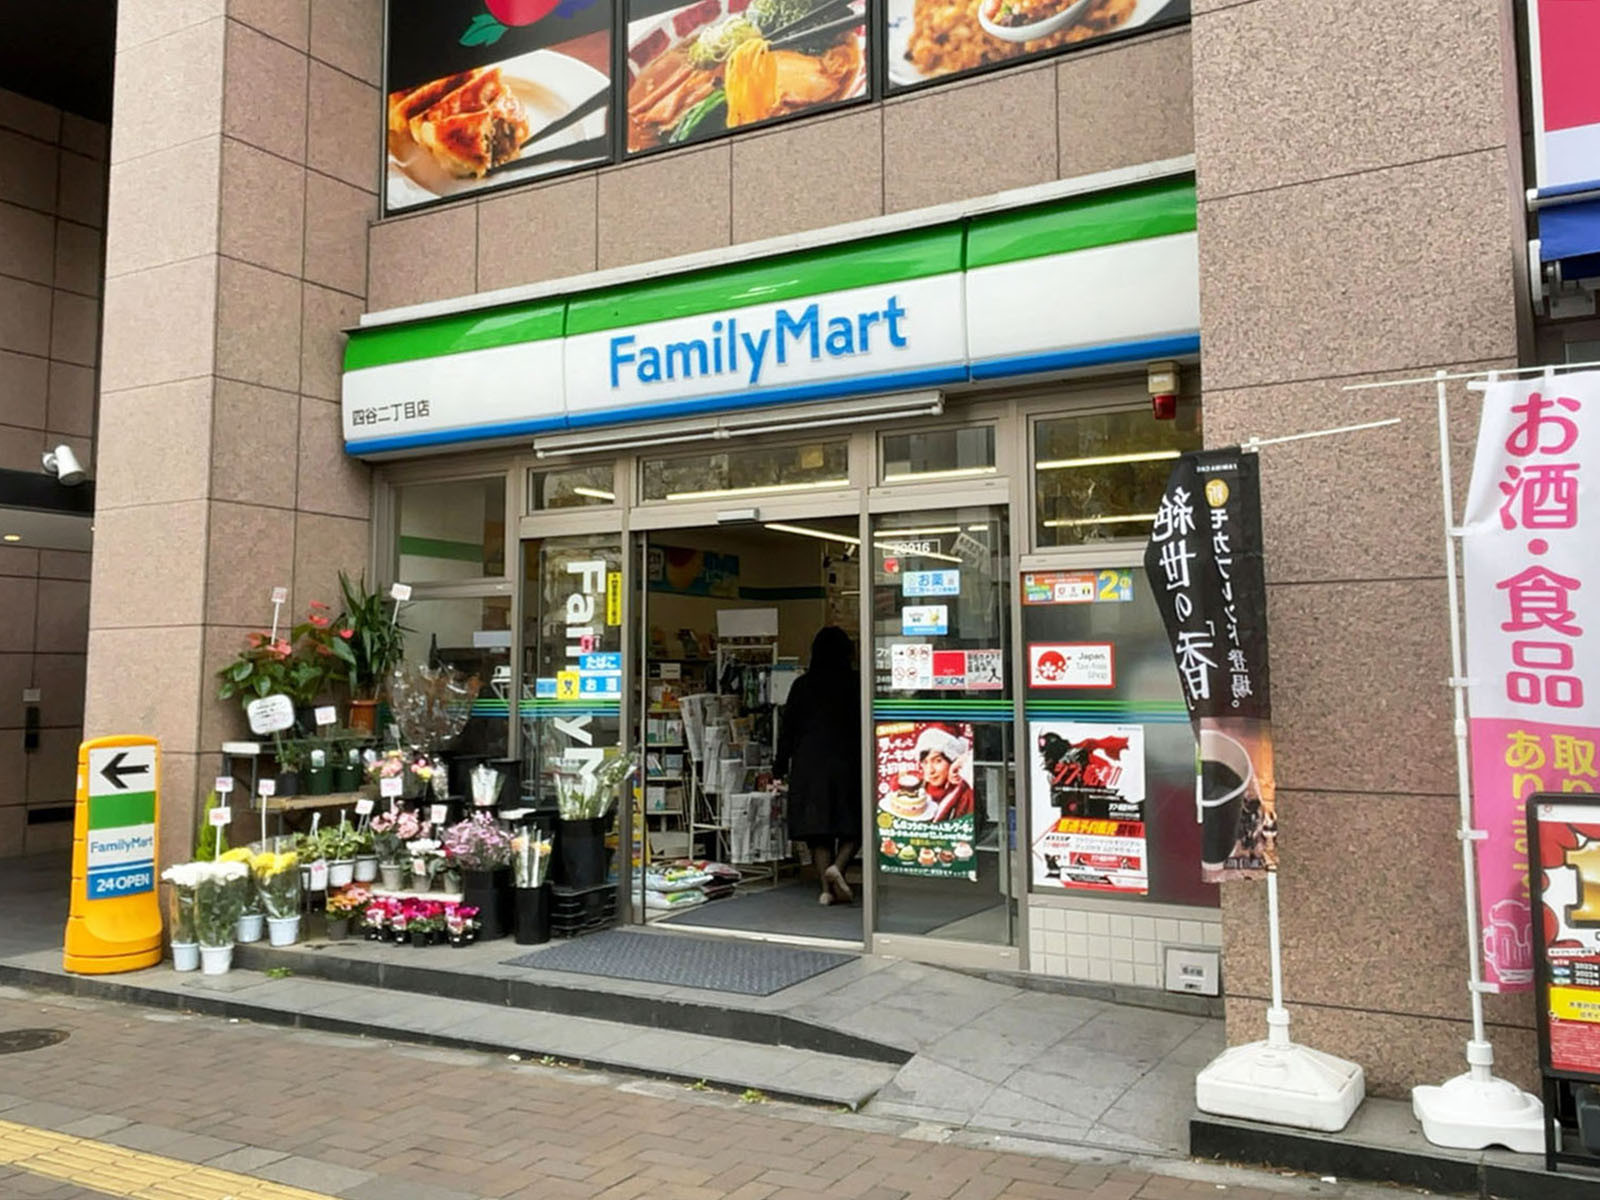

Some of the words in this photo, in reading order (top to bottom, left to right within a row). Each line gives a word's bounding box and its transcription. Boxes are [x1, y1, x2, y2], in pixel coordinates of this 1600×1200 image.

[609, 295, 907, 389] FamilyMart
[352, 399, 430, 426] 四谷二丁目店
[1496, 391, 1584, 709] お酒・食品
[90, 836, 153, 853] FamilyMart
[96, 878, 114, 893] 24
[115, 873, 150, 890] OPEN
